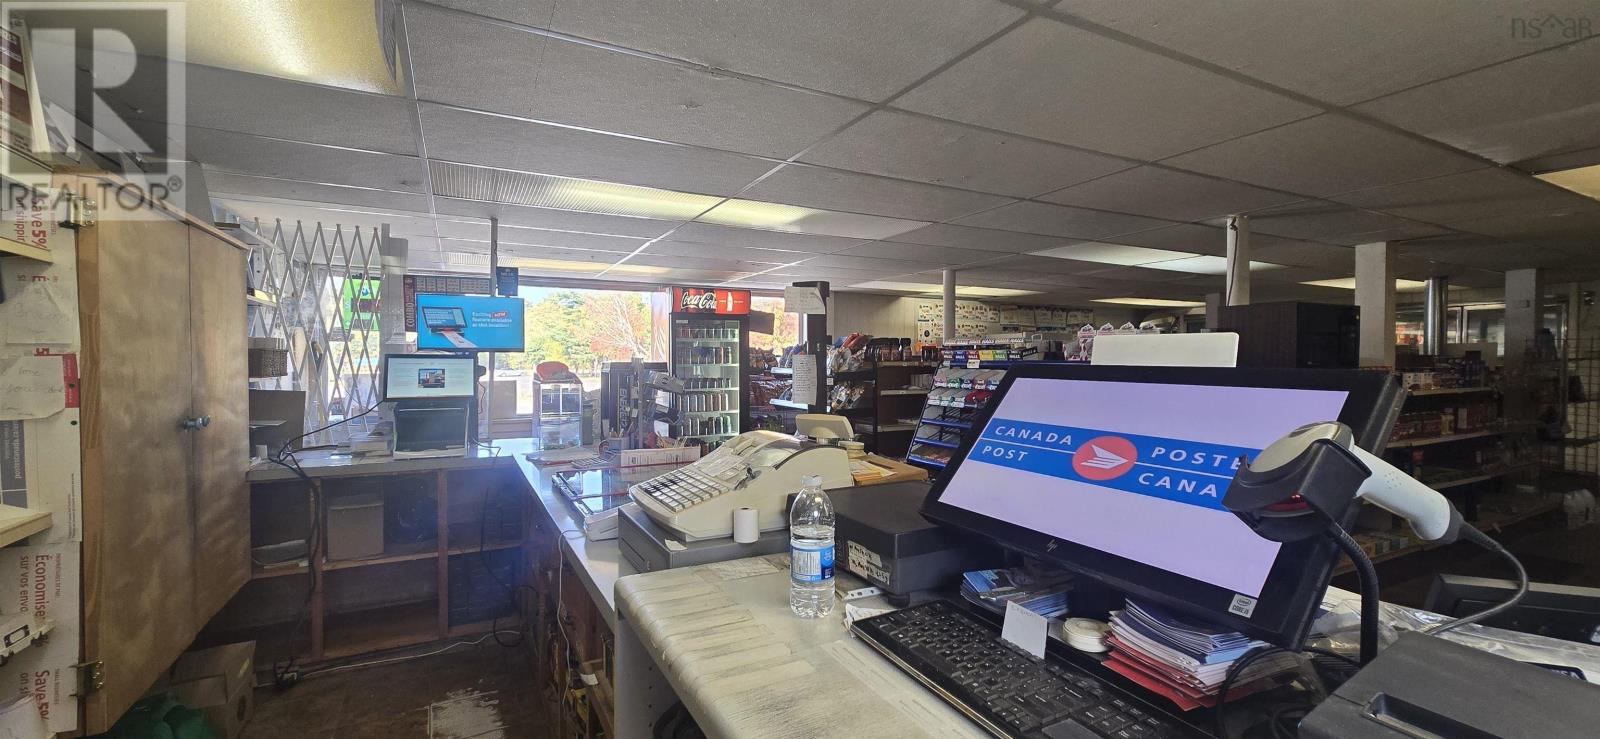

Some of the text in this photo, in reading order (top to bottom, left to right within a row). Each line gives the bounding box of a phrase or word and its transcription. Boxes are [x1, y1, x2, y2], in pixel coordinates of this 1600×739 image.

[13, 210, 28, 242] shippin
[31, 197, 46, 228] Save
[995, 425, 1074, 446] CANADA
[981, 445, 1029, 462] POST
[1151, 446, 1242, 471] POSTE
[1137, 472, 1219, 499] CANA
[19, 556, 30, 612] sur vos envo
[35, 554, 53, 619] Économise
[35, 670, 50, 700] Save
